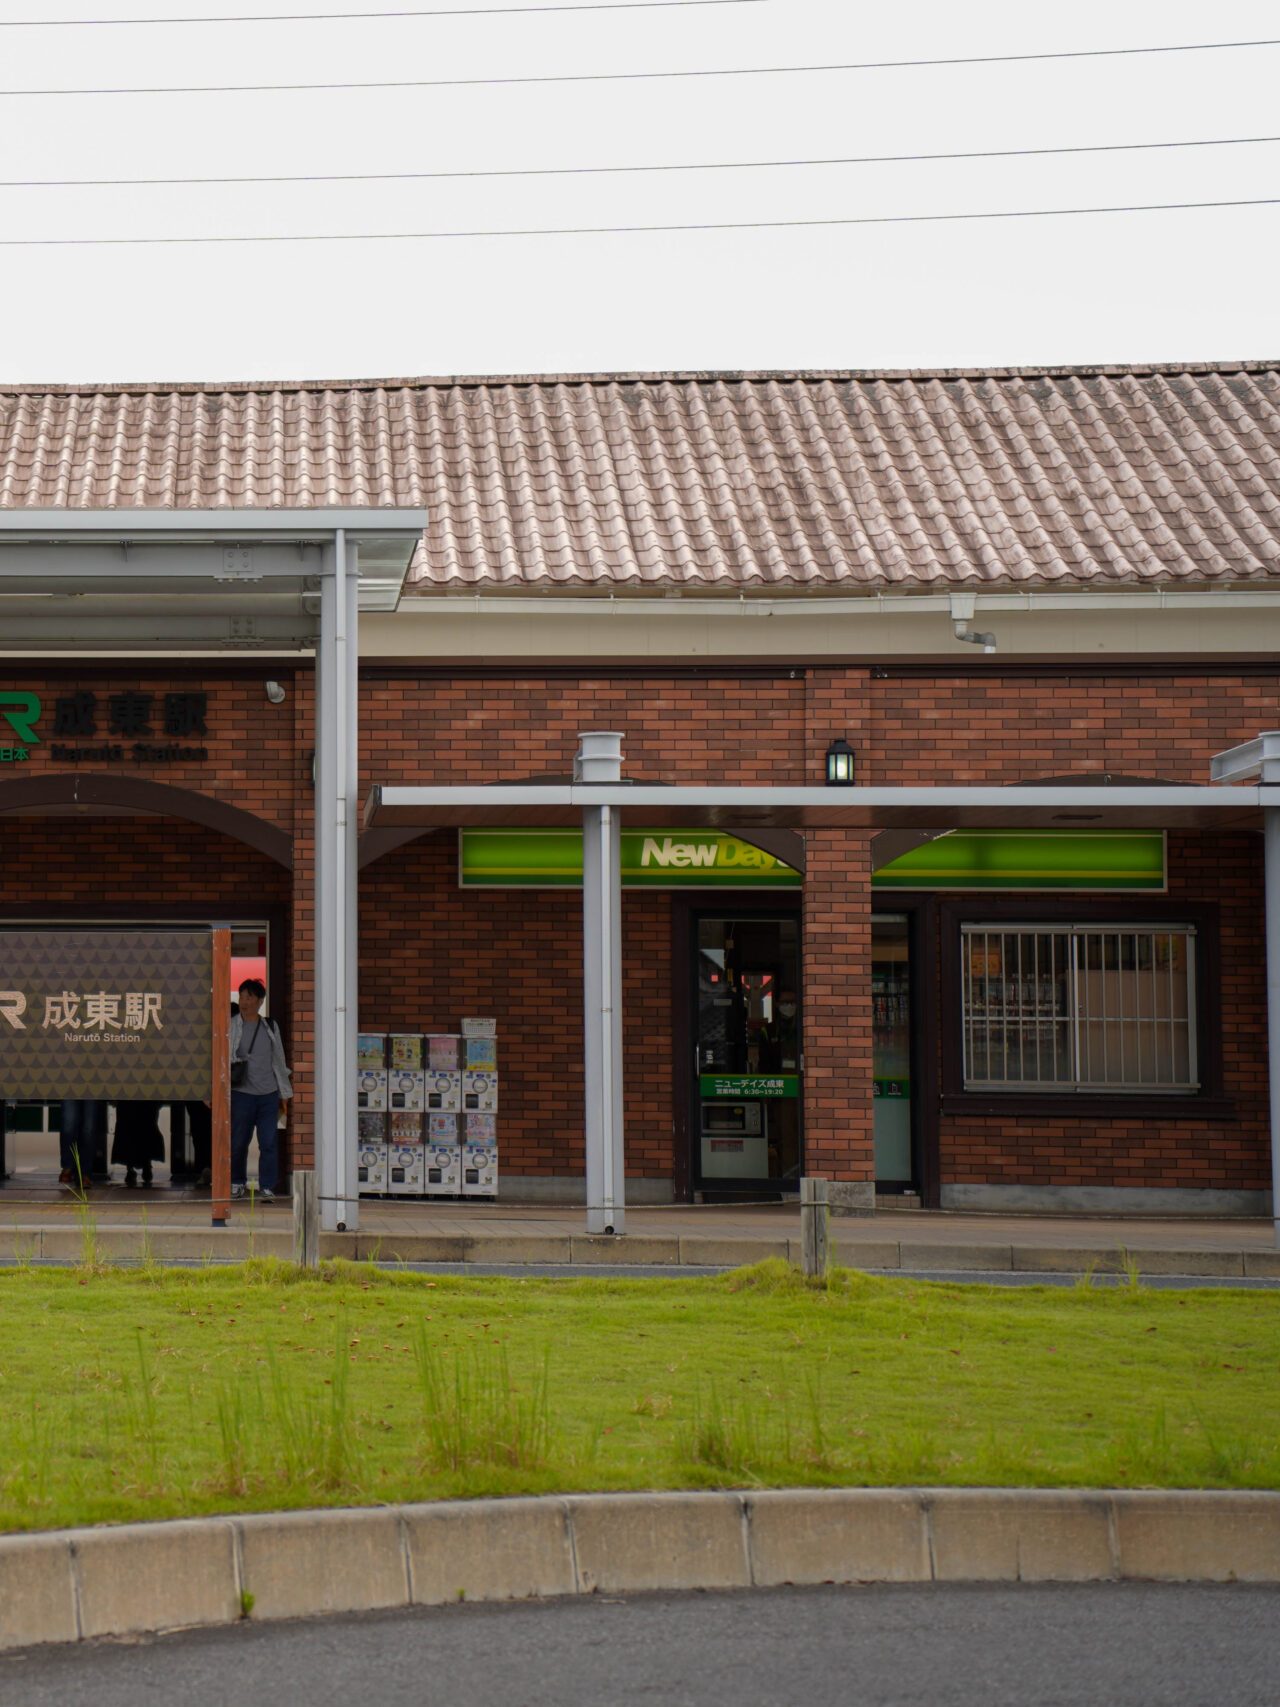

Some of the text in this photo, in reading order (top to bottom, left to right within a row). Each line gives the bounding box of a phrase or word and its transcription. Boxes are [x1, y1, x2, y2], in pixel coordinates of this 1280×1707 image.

[53, 690, 208, 736] 成東駅
[132, 743, 208, 761] Station
[641, 837, 790, 869] NewDay
[42, 990, 163, 1031] 成東駅
[64, 1032, 141, 1042] Narutō Station
[714, 1079, 785, 1088] ニューデイズ成東
